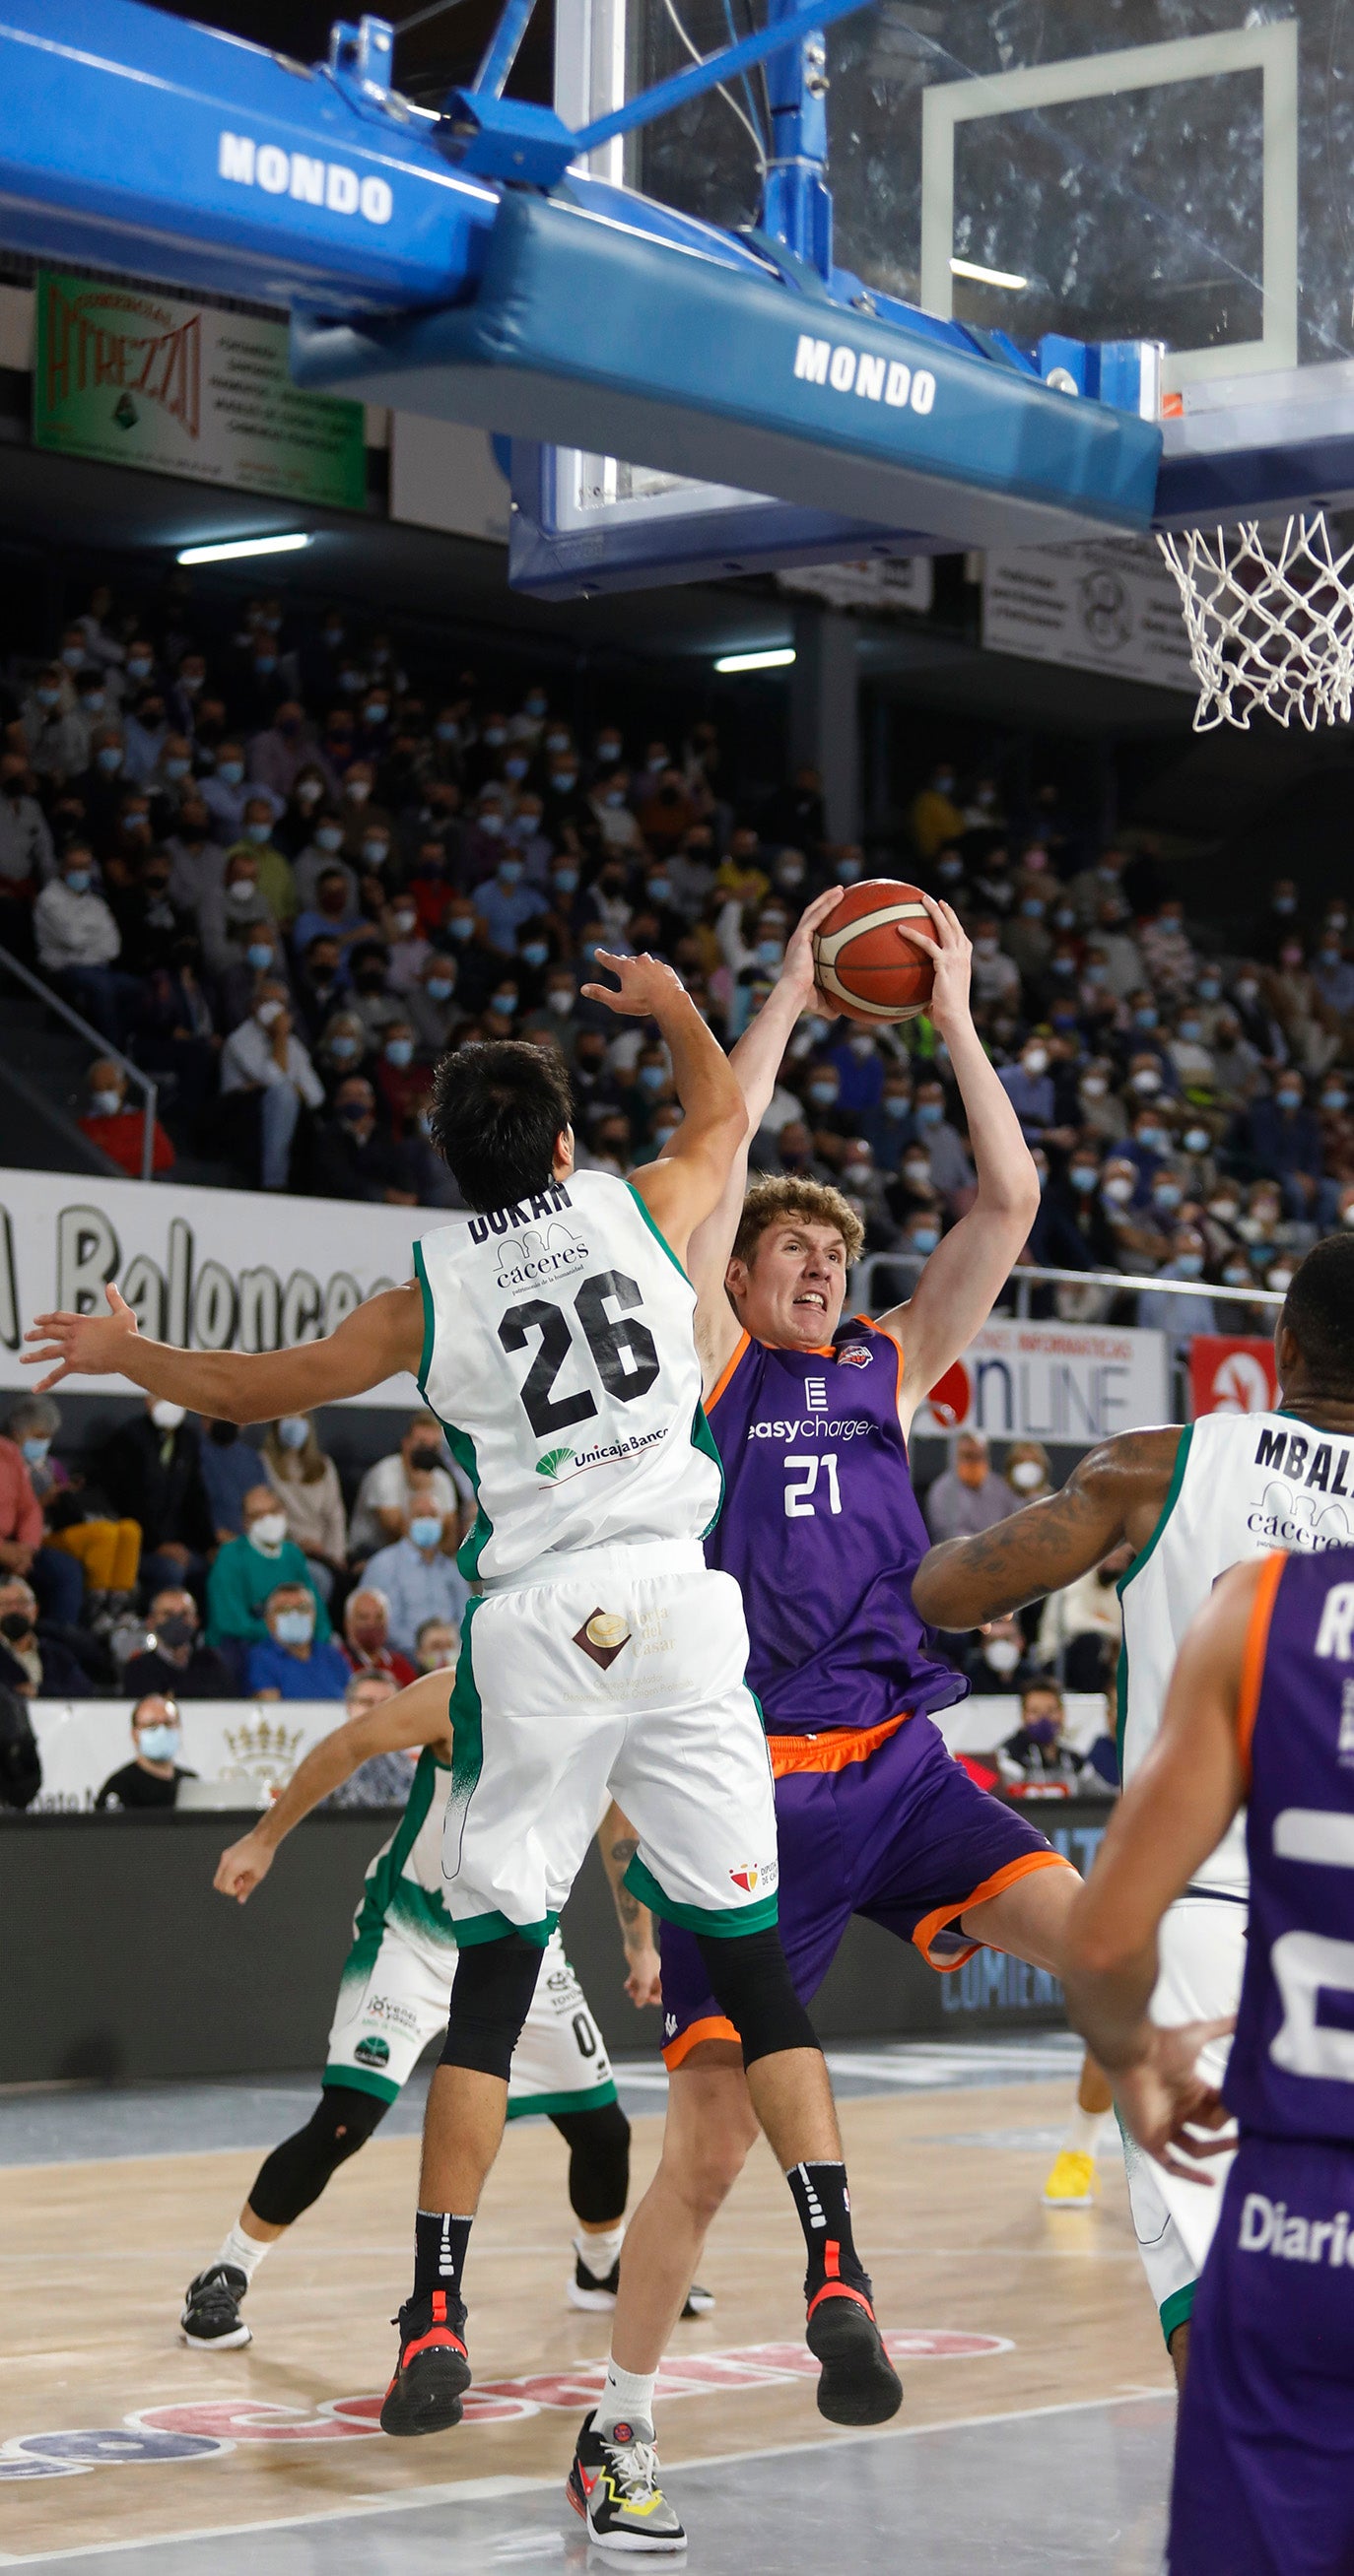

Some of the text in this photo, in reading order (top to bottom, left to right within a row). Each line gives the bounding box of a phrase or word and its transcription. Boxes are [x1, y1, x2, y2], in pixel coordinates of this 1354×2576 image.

[219, 132, 392, 226] MONDO
[793, 334, 937, 415] MONDO
[57, 1204, 398, 1354] Balonce
[497, 1242, 589, 1289] cáceres
[498, 1269, 660, 1438] 26
[783, 1453, 843, 1518] 21
[1254, 1428, 1354, 1498] MBAL
[573, 2013, 596, 2058] 0
